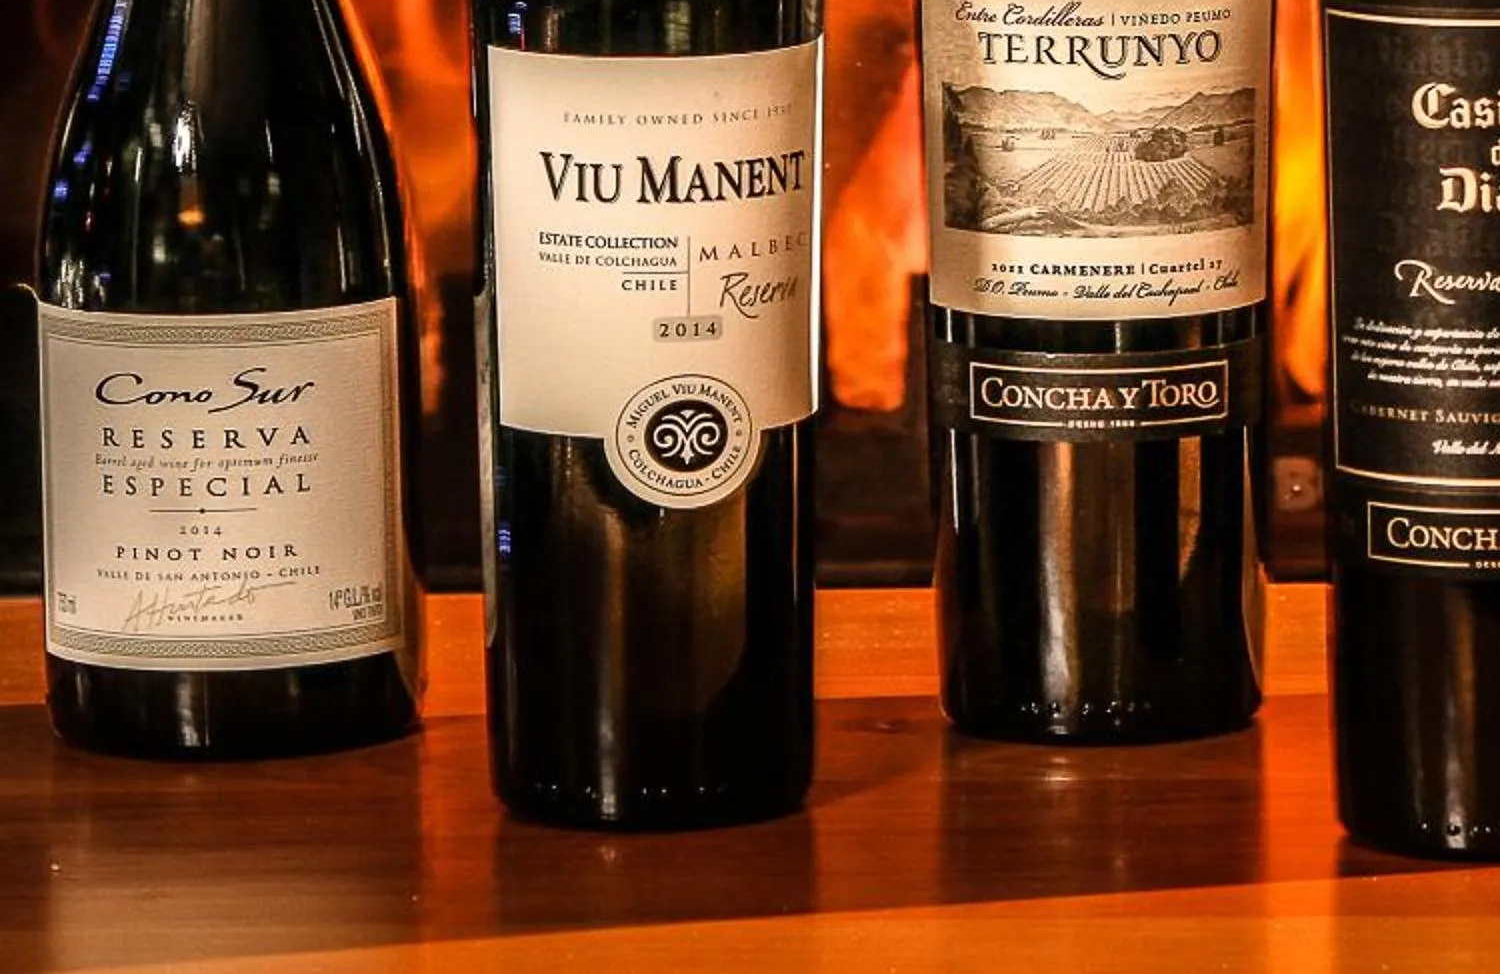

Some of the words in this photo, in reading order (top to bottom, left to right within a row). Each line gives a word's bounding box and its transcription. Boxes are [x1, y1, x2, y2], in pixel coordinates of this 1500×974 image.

[1002, 1, 1104, 27] Cordilleras
[1186, 8, 1231, 24] PEUMO
[977, 29, 1224, 81] TERRUNYO
[563, 113, 626, 126] FAMILY
[636, 113, 704, 126] OWNED
[713, 109, 759, 124] SINCE
[636, 150, 805, 204] MANENT
[539, 232, 583, 249] ESTATE
[585, 235, 679, 250] COLLECTION
[699, 232, 808, 263] MALBEC
[539, 252, 571, 265] VALLE
[575, 255, 591, 266] DE
[595, 254, 678, 268] COLCHAGUA
[1030, 263, 1136, 276] CARMENERE
[1149, 258, 1205, 275] Cuartel
[621, 279, 678, 291] CHILE
[1112, 283, 1137, 299] del
[659, 322, 718, 338] 2014
[95, 373, 213, 405] Cono
[208, 367, 315, 414] Sur
[981, 377, 1114, 410] CONCHA
[1118, 387, 1140, 408] Y
[1142, 379, 1220, 409] TORO
[626, 389, 671, 429] MIGUEL
[671, 383, 697, 395] VIU
[698, 383, 743, 423] MANENT
[103, 426, 310, 449] RESERVA
[628, 449, 703, 489] COLCHAGUA
[711, 445, 741, 479] CHILE
[103, 473, 311, 497] ESPECIAL
[116, 546, 202, 561] PINOT
[223, 544, 298, 561] NOIR
[135, 571, 151, 582] DE
[158, 571, 183, 582] SAN
[191, 570, 261, 583] ANTONIO
[279, 566, 320, 577] CHILE
